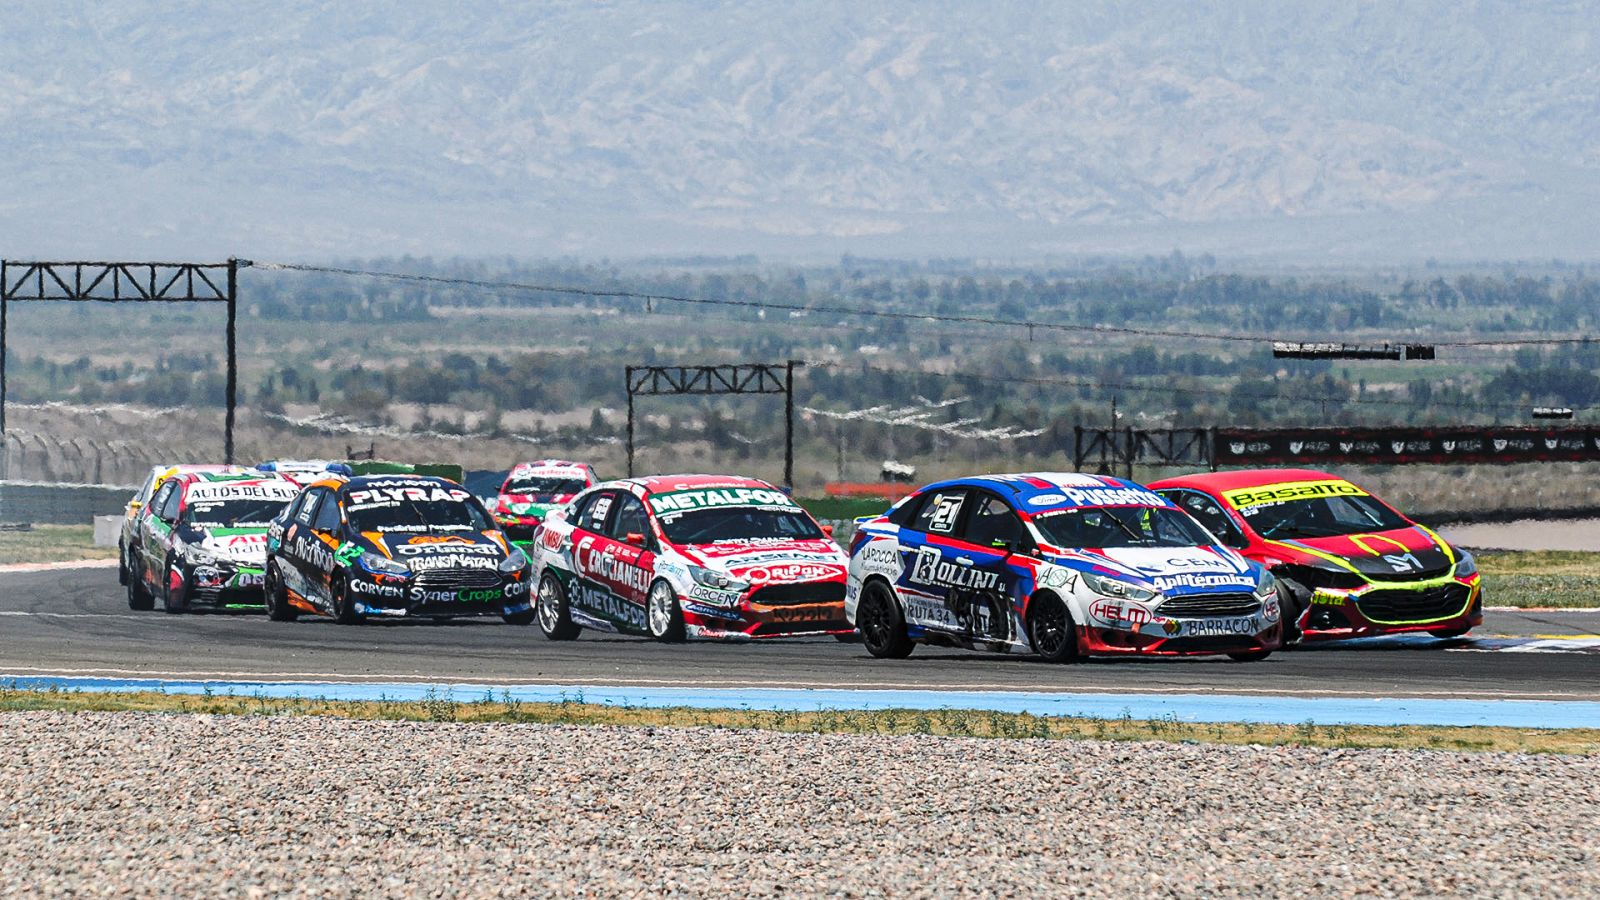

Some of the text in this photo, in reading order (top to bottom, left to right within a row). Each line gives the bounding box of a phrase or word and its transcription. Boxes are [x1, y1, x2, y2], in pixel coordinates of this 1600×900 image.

[191, 487, 240, 498] AUTOS
[241, 486, 271, 497] DEL
[349, 488, 471, 504] PLYRAP
[649, 489, 793, 513] METALFOR
[1060, 487, 1167, 506] Pussetto
[933, 501, 961, 524] 21
[863, 547, 897, 565] LAROCCA
[1166, 557, 1230, 568] CEM
[909, 545, 1000, 589] BOLLINI
[350, 578, 404, 598] CORVEN
[1153, 572, 1257, 592] Aplitérmica
[581, 586, 648, 631] METALFOR
[906, 604, 934, 621] RUTA
[936, 608, 950, 623] 34
[1094, 603, 1146, 624] HELM
[1188, 618, 1259, 636] BARRACON
